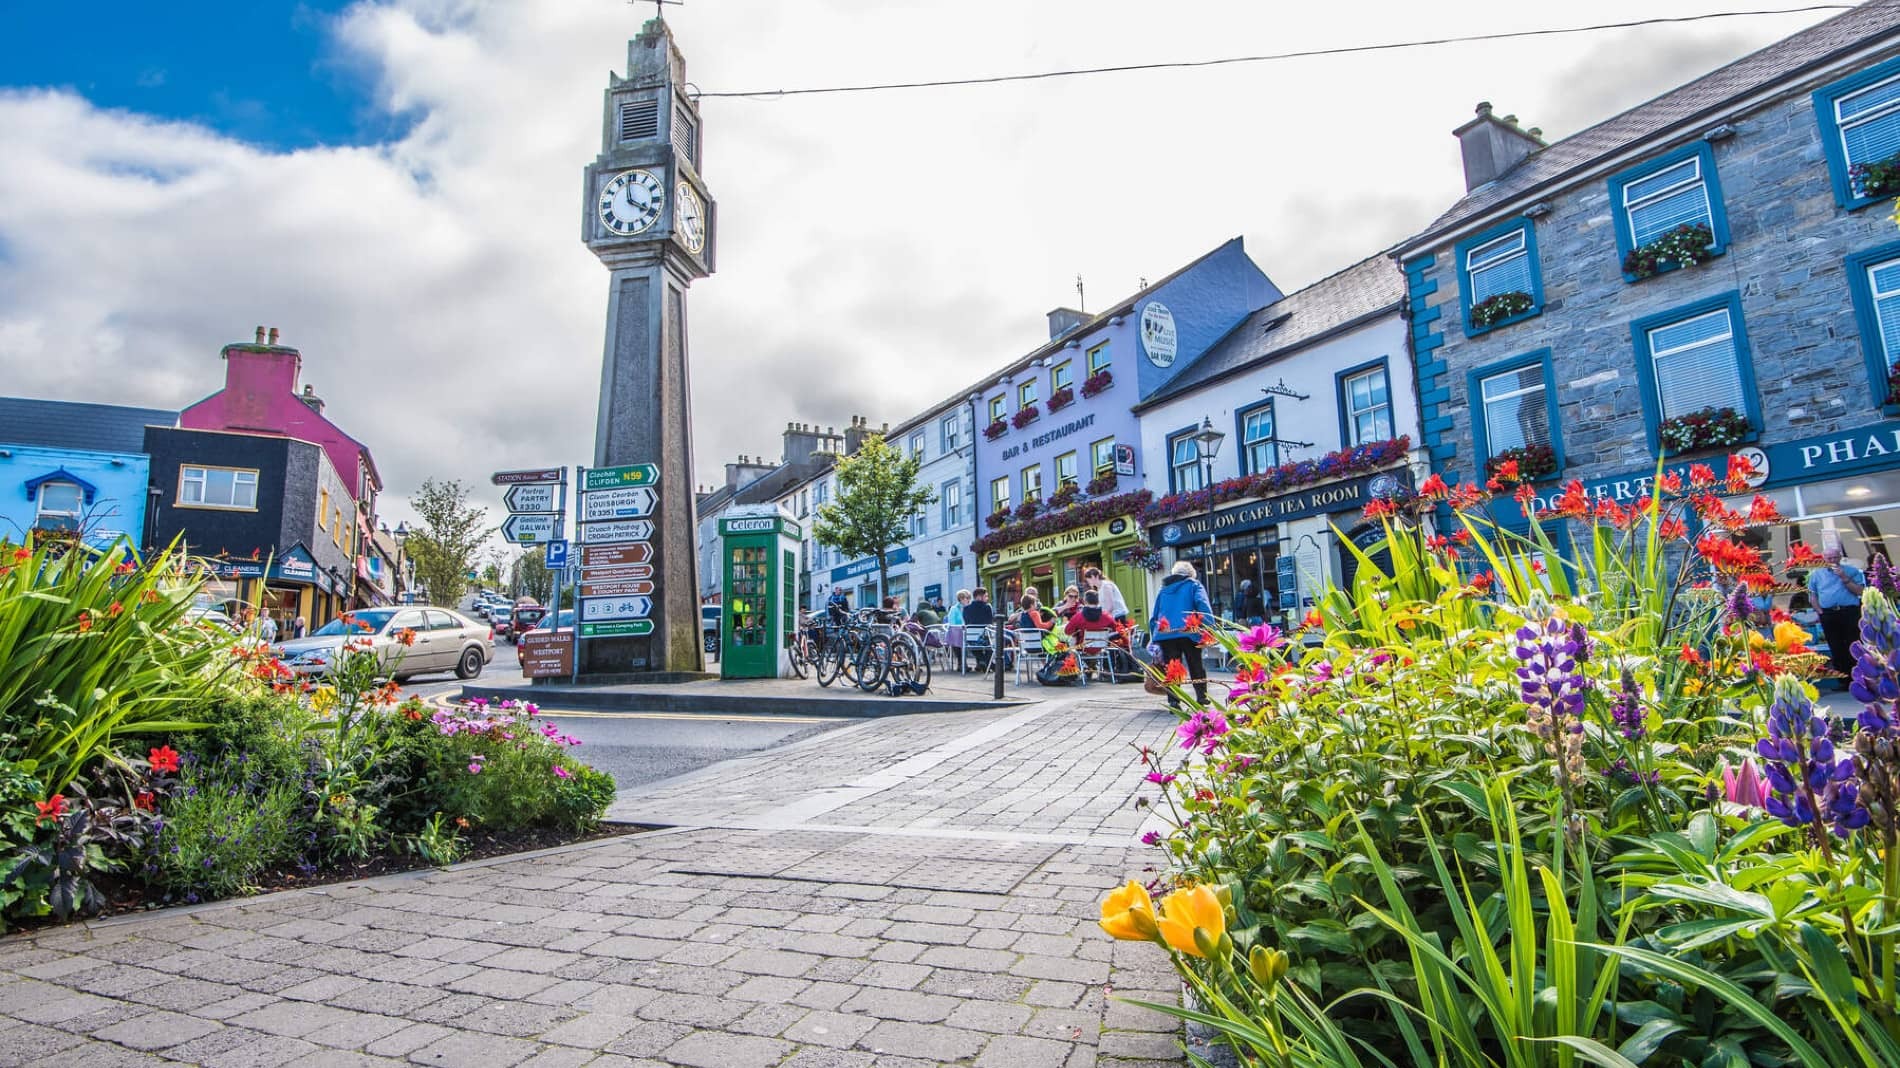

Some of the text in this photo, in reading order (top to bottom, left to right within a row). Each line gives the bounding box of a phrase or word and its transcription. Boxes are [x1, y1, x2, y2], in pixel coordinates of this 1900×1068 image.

[1002, 414, 1096, 461] BAR & RESTAURANT
[623, 471, 642, 480] N59
[589, 478, 620, 486] CLIFDEN
[520, 503, 541, 511] R330
[588, 499, 636, 508] LOUISBURGH
[1186, 512, 1237, 534] WILOW
[1239, 501, 1273, 523] CAFÉ
[1279, 496, 1306, 514] TEA
[1312, 484, 1360, 507] ROOM
[614, 531, 640, 539] PATRICK
[1007, 526, 1099, 558] THE CLOCK TAVERN
[550, 543, 565, 560] P
[283, 569, 313, 577] CLEANERS
[533, 648, 563, 656] WESTPORT
